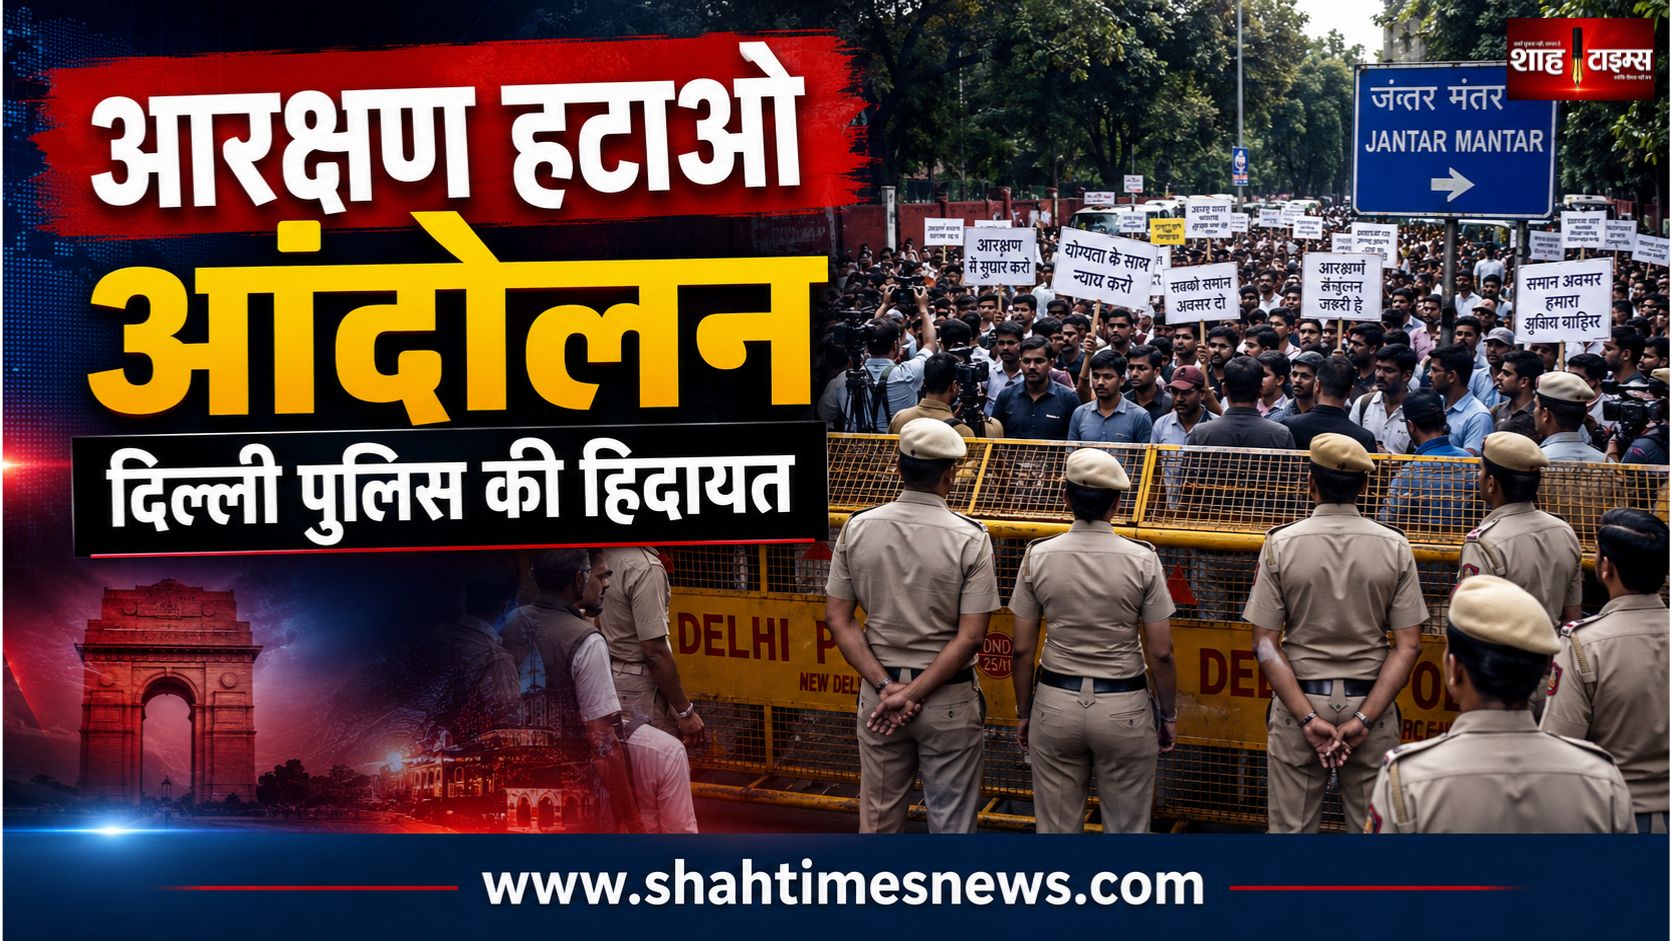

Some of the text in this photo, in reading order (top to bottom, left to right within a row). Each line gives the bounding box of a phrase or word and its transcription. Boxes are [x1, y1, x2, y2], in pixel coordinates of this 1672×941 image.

[1448, 78, 1506, 111] मंतर
[1365, 129, 1544, 153] JANTAR MANTAR
[1065, 239, 1107, 264] योग्यता
[1010, 257, 1031, 274] करो
[1107, 274, 1134, 294] करो
[1526, 276, 1560, 290] समान
[1176, 299, 1211, 312] अवसर
[1545, 295, 1580, 311] हमारा
[677, 612, 790, 662] DELHI
[800, 672, 829, 692] NEW
